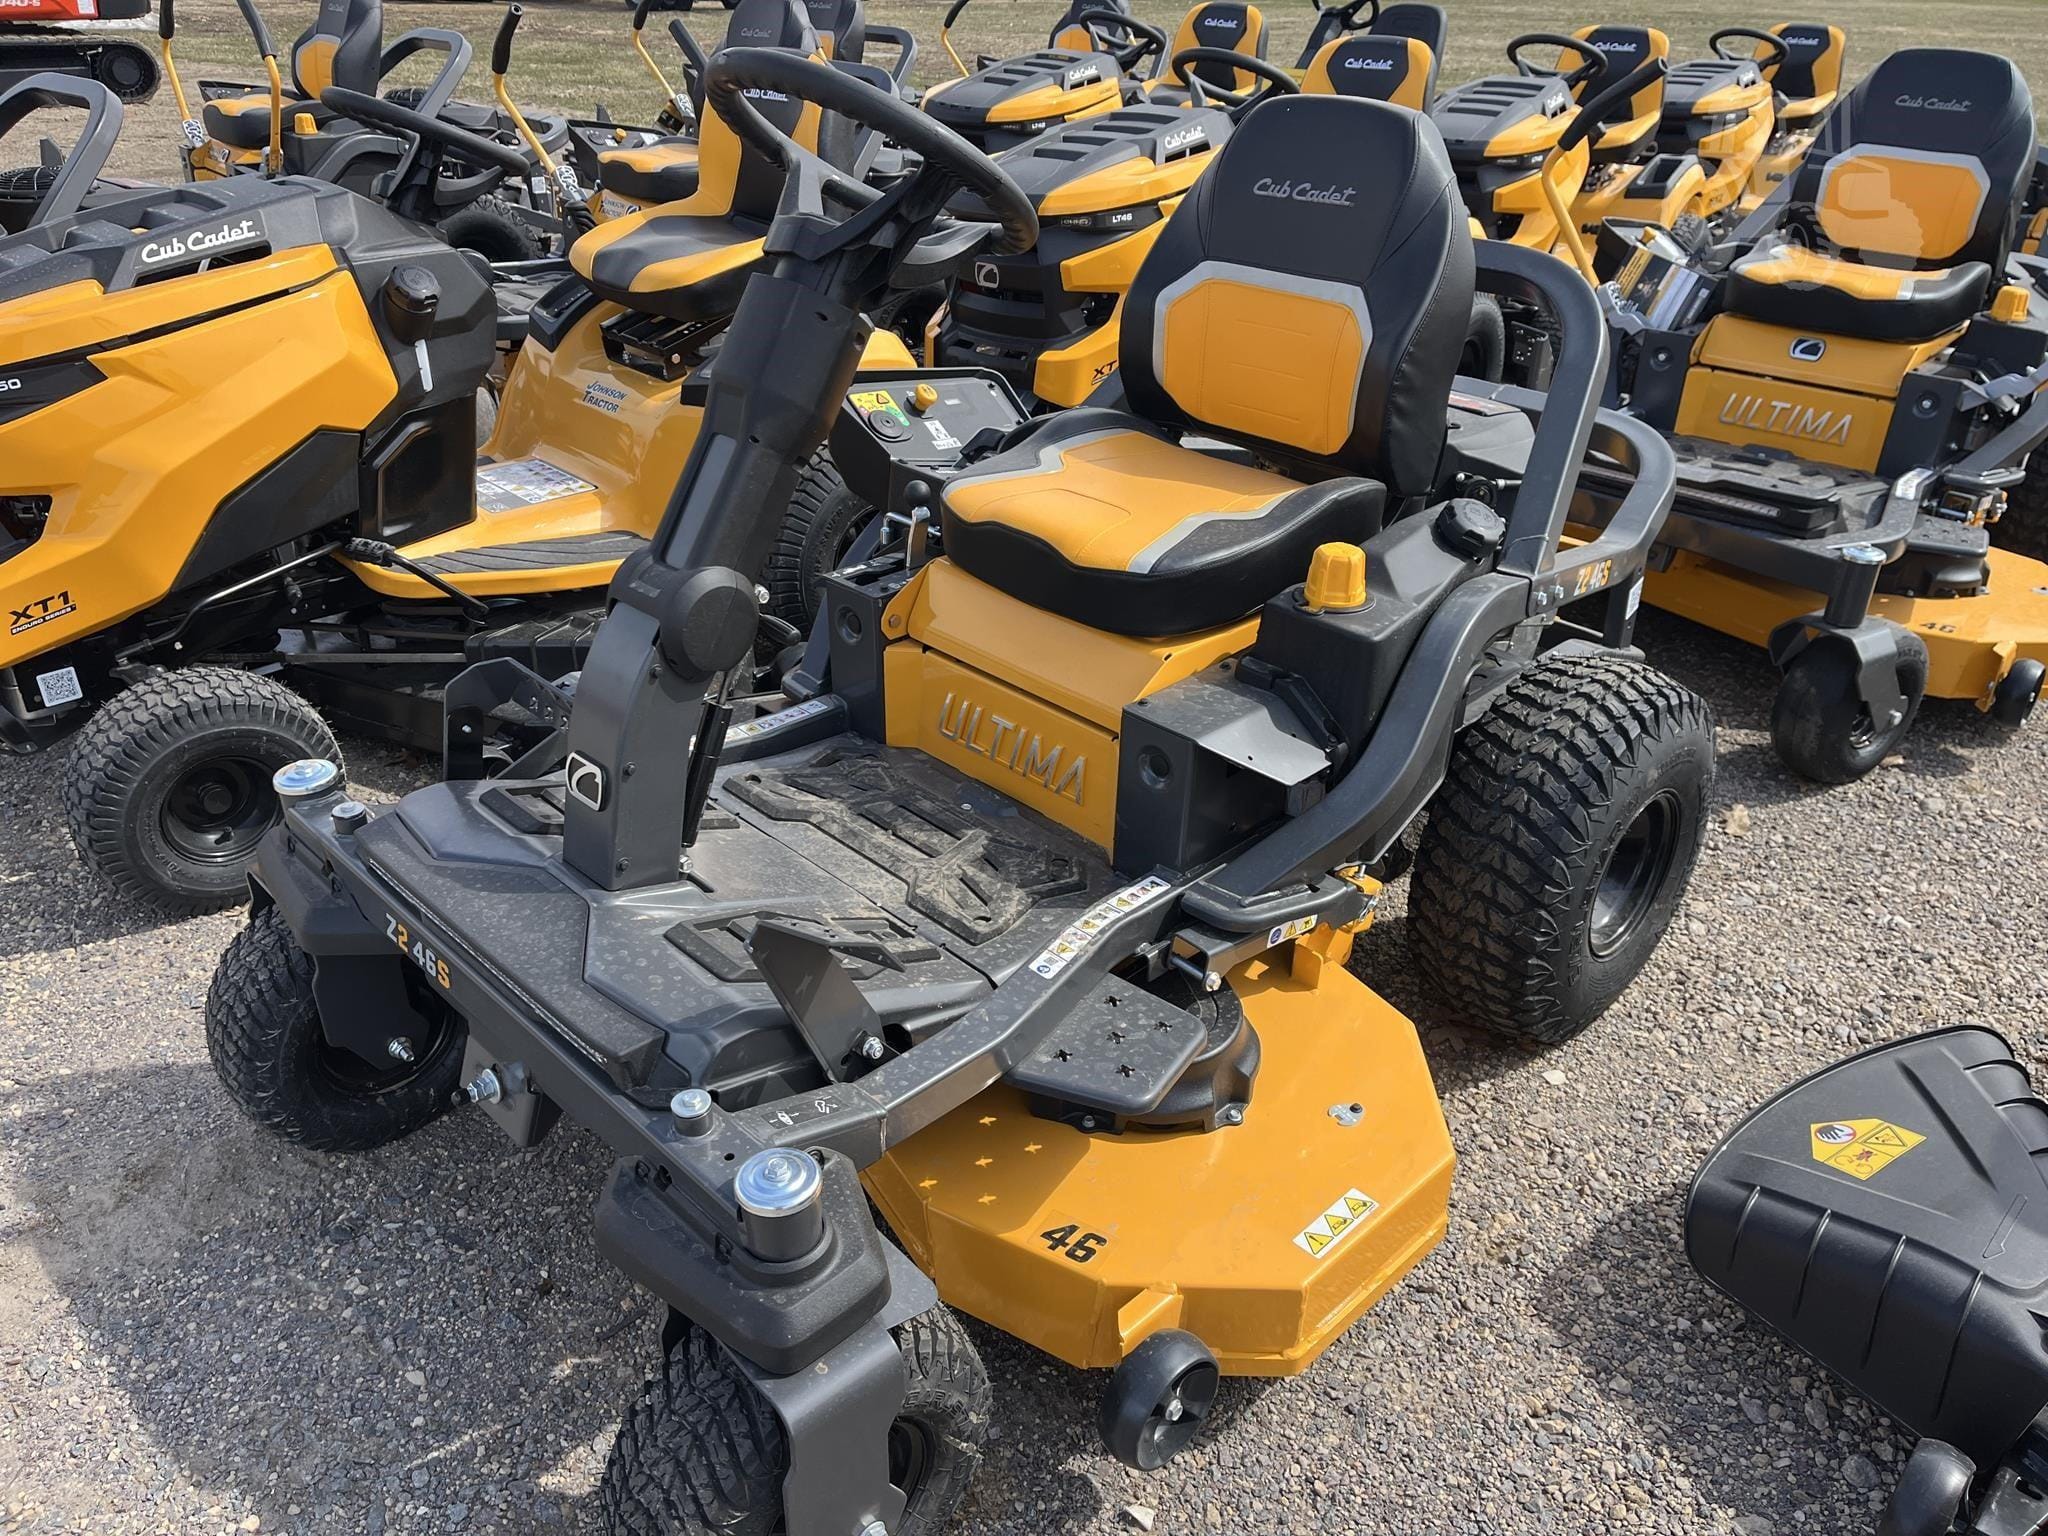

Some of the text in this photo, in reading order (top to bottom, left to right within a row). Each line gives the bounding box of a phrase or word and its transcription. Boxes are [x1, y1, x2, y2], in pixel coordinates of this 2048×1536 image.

[1345, 57, 1394, 71] Cub Cadet
[1894, 94, 1972, 112] Cub Cadet
[1164, 125, 1206, 149] Cub Cadet
[1253, 177, 1356, 207] Cub Cadet
[1112, 213, 1133, 224] LT46
[141, 219, 260, 263] Cub Cadet
[581, 390, 620, 413] TRACTOR
[586, 380, 628, 401] JOHNSON
[1719, 392, 1853, 447] ULTIMA
[9, 590, 70, 627] XT1
[11, 606, 72, 635] ENDURO SERIES
[938, 691, 1089, 806] ULTIMA
[1039, 1223, 1108, 1264] 46
